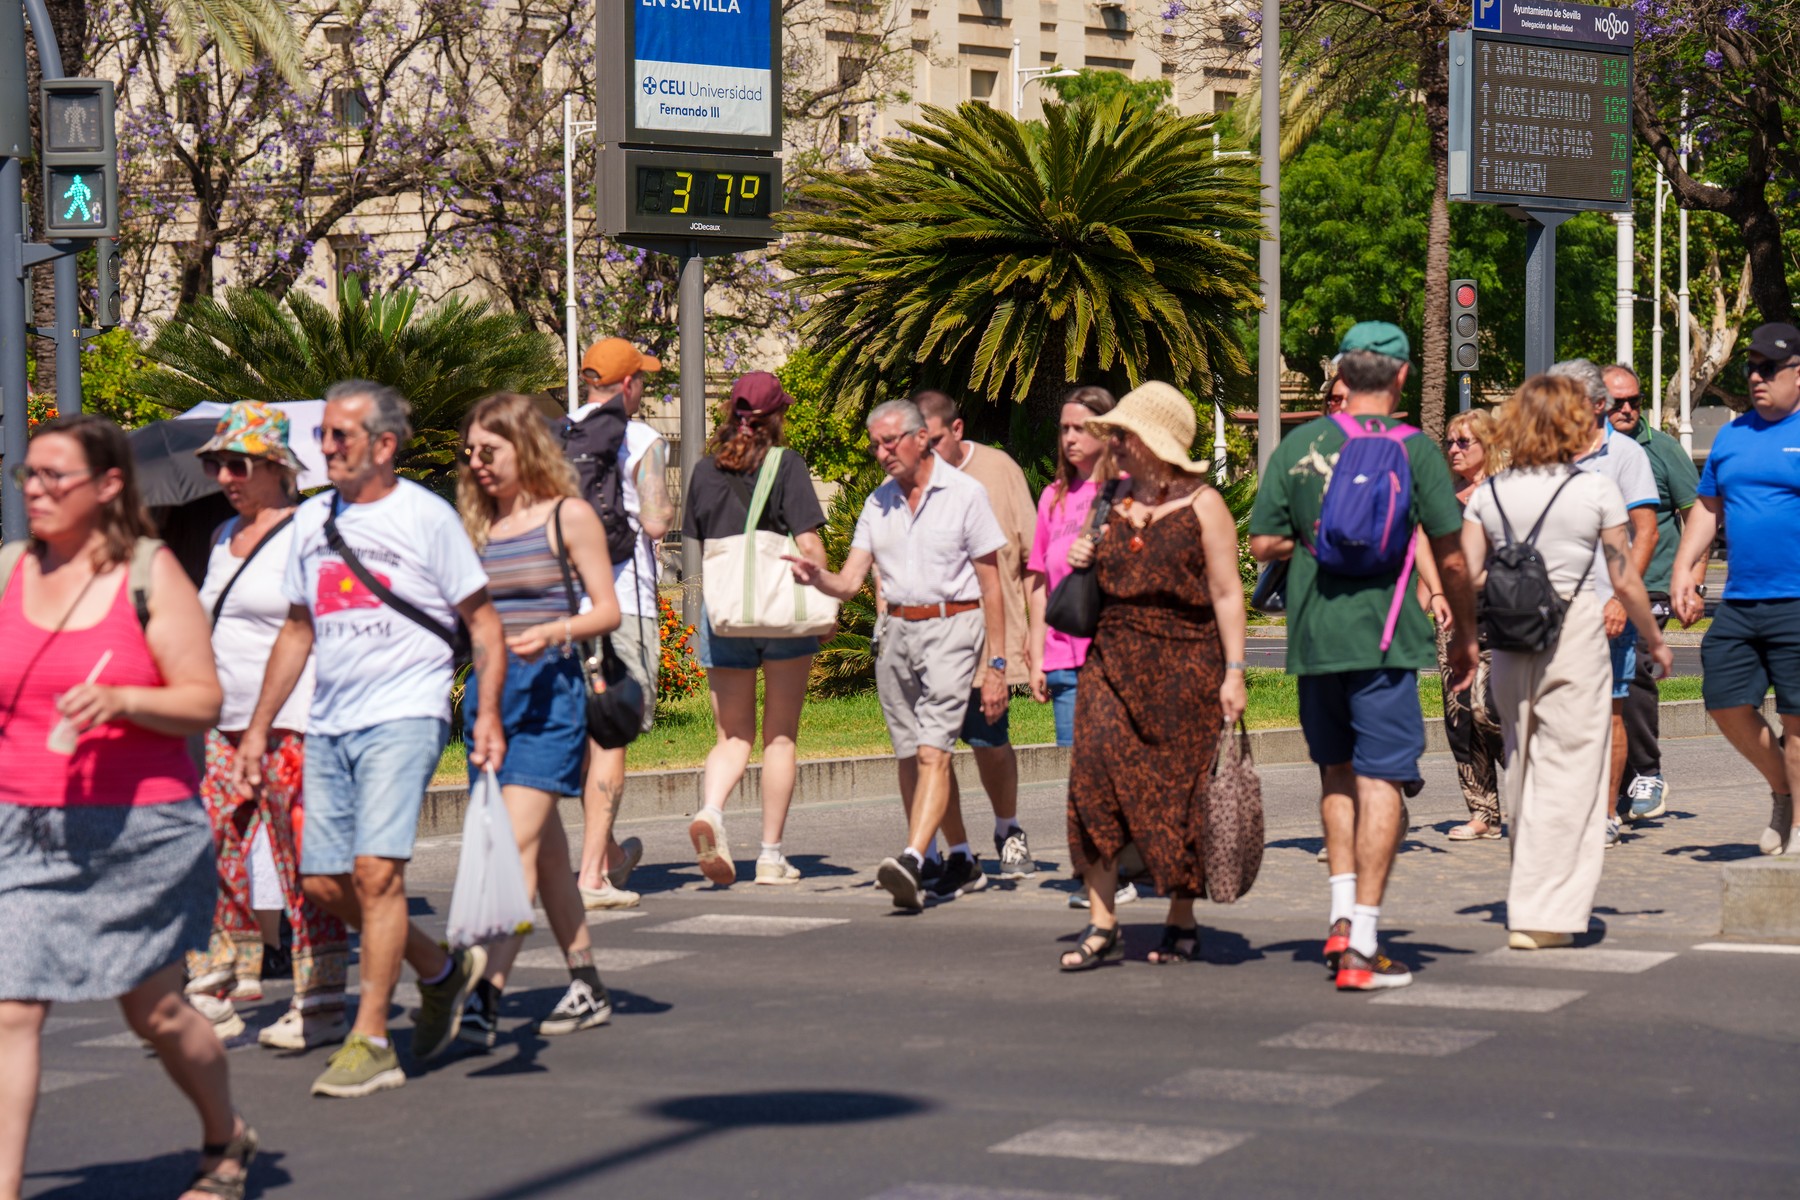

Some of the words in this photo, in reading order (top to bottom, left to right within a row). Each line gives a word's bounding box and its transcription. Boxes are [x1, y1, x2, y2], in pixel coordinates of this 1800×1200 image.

[1480, 0, 1495, 19] P
[1513, 3, 1553, 16] Ayuntamiento
[1554, 8, 1562, 18] de
[1562, 9, 1581, 20] Sevilla
[1521, 19, 1546, 30] Delegación
[1552, 23, 1574, 33] Movilidad
[1495, 46, 1523, 75] SAN
[1527, 49, 1597, 84] BERNARDO
[659, 79, 685, 96] CEU
[689, 81, 762, 101] Universidad
[660, 103, 708, 118] Fernando
[710, 106, 720, 118] III
[1494, 160, 1547, 193] IMAGEN
[690, 222, 721, 231] JCDecaux
